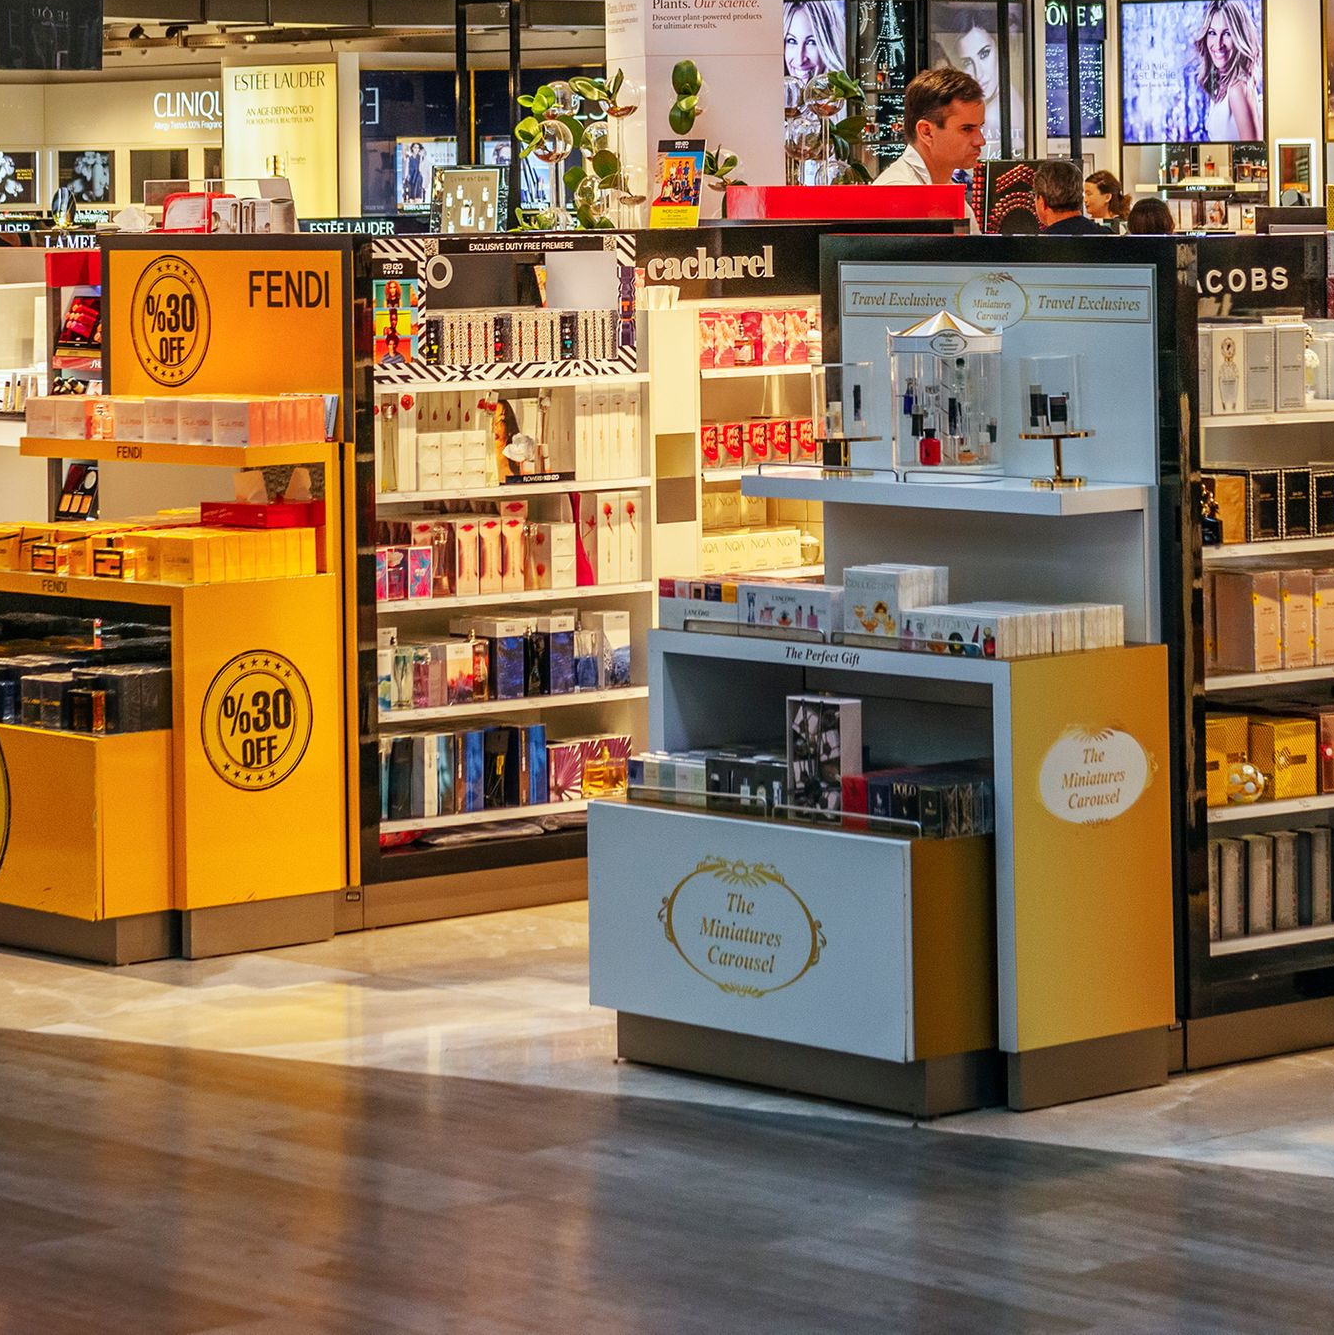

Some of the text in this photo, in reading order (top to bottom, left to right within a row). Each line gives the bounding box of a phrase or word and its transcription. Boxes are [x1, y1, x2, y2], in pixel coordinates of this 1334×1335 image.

[652, 12, 762, 22] Discover plant-powered products
[652, 21, 717, 30] for ultimate results.
[274, 70, 325, 89] LAUDER
[153, 90, 222, 121] CLINIQU
[299, 105, 314, 114] TRIO
[344, 220, 395, 235] LAUDER
[468, 241, 574, 252] EXCLUSIVE DUTY FREE PREMIERE
[648, 245, 775, 281] cacharel
[249, 269, 330, 309] FENDI
[1197, 267, 1289, 294] COBS
[851, 291, 948, 308] Travel Exclusives
[984, 285, 999, 297] The
[145, 292, 196, 334] %30
[972, 298, 1012, 311] Miniatures
[1038, 294, 1141, 313] Travel Exclusives
[975, 309, 1009, 322] Carousel
[159, 337, 186, 366] OFF
[116, 445, 143, 459] FENDI
[42, 579, 67, 594] FENDI
[785, 646, 861, 666] The Perfect Gift
[223, 687, 293, 738] %30
[241, 735, 279, 768] OFF
[1082, 747, 1106, 765] The
[1062, 767, 1126, 791] Miniatures
[891, 782, 917, 796] POLO
[1067, 787, 1121, 811] Carousel
[726, 892, 754, 916] The
[699, 916, 782, 949] Miniatures
[707, 944, 775, 975] Carousel
